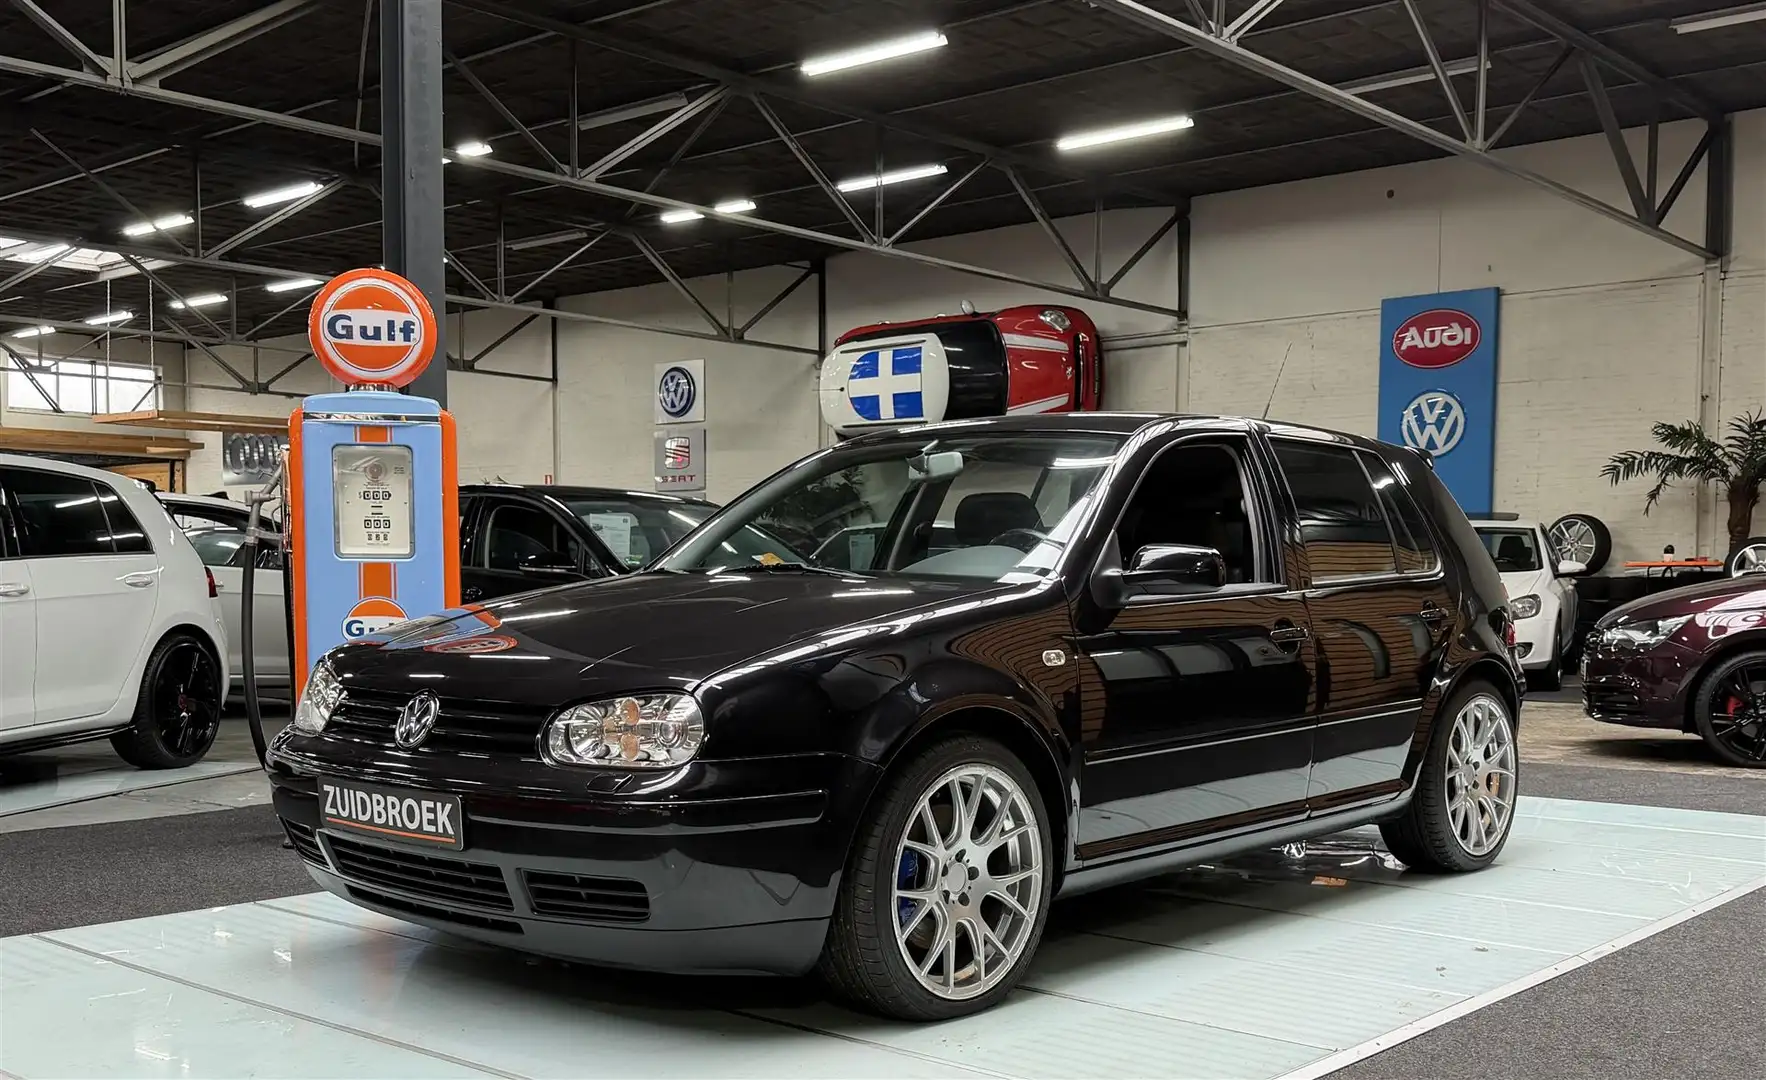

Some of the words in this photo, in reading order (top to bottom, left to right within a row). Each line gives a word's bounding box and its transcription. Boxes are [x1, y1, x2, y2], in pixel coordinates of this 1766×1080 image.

[327, 314, 416, 342] Gulf
[661, 474, 696, 483] SEAT
[323, 784, 455, 835] ZUIDBROEK
